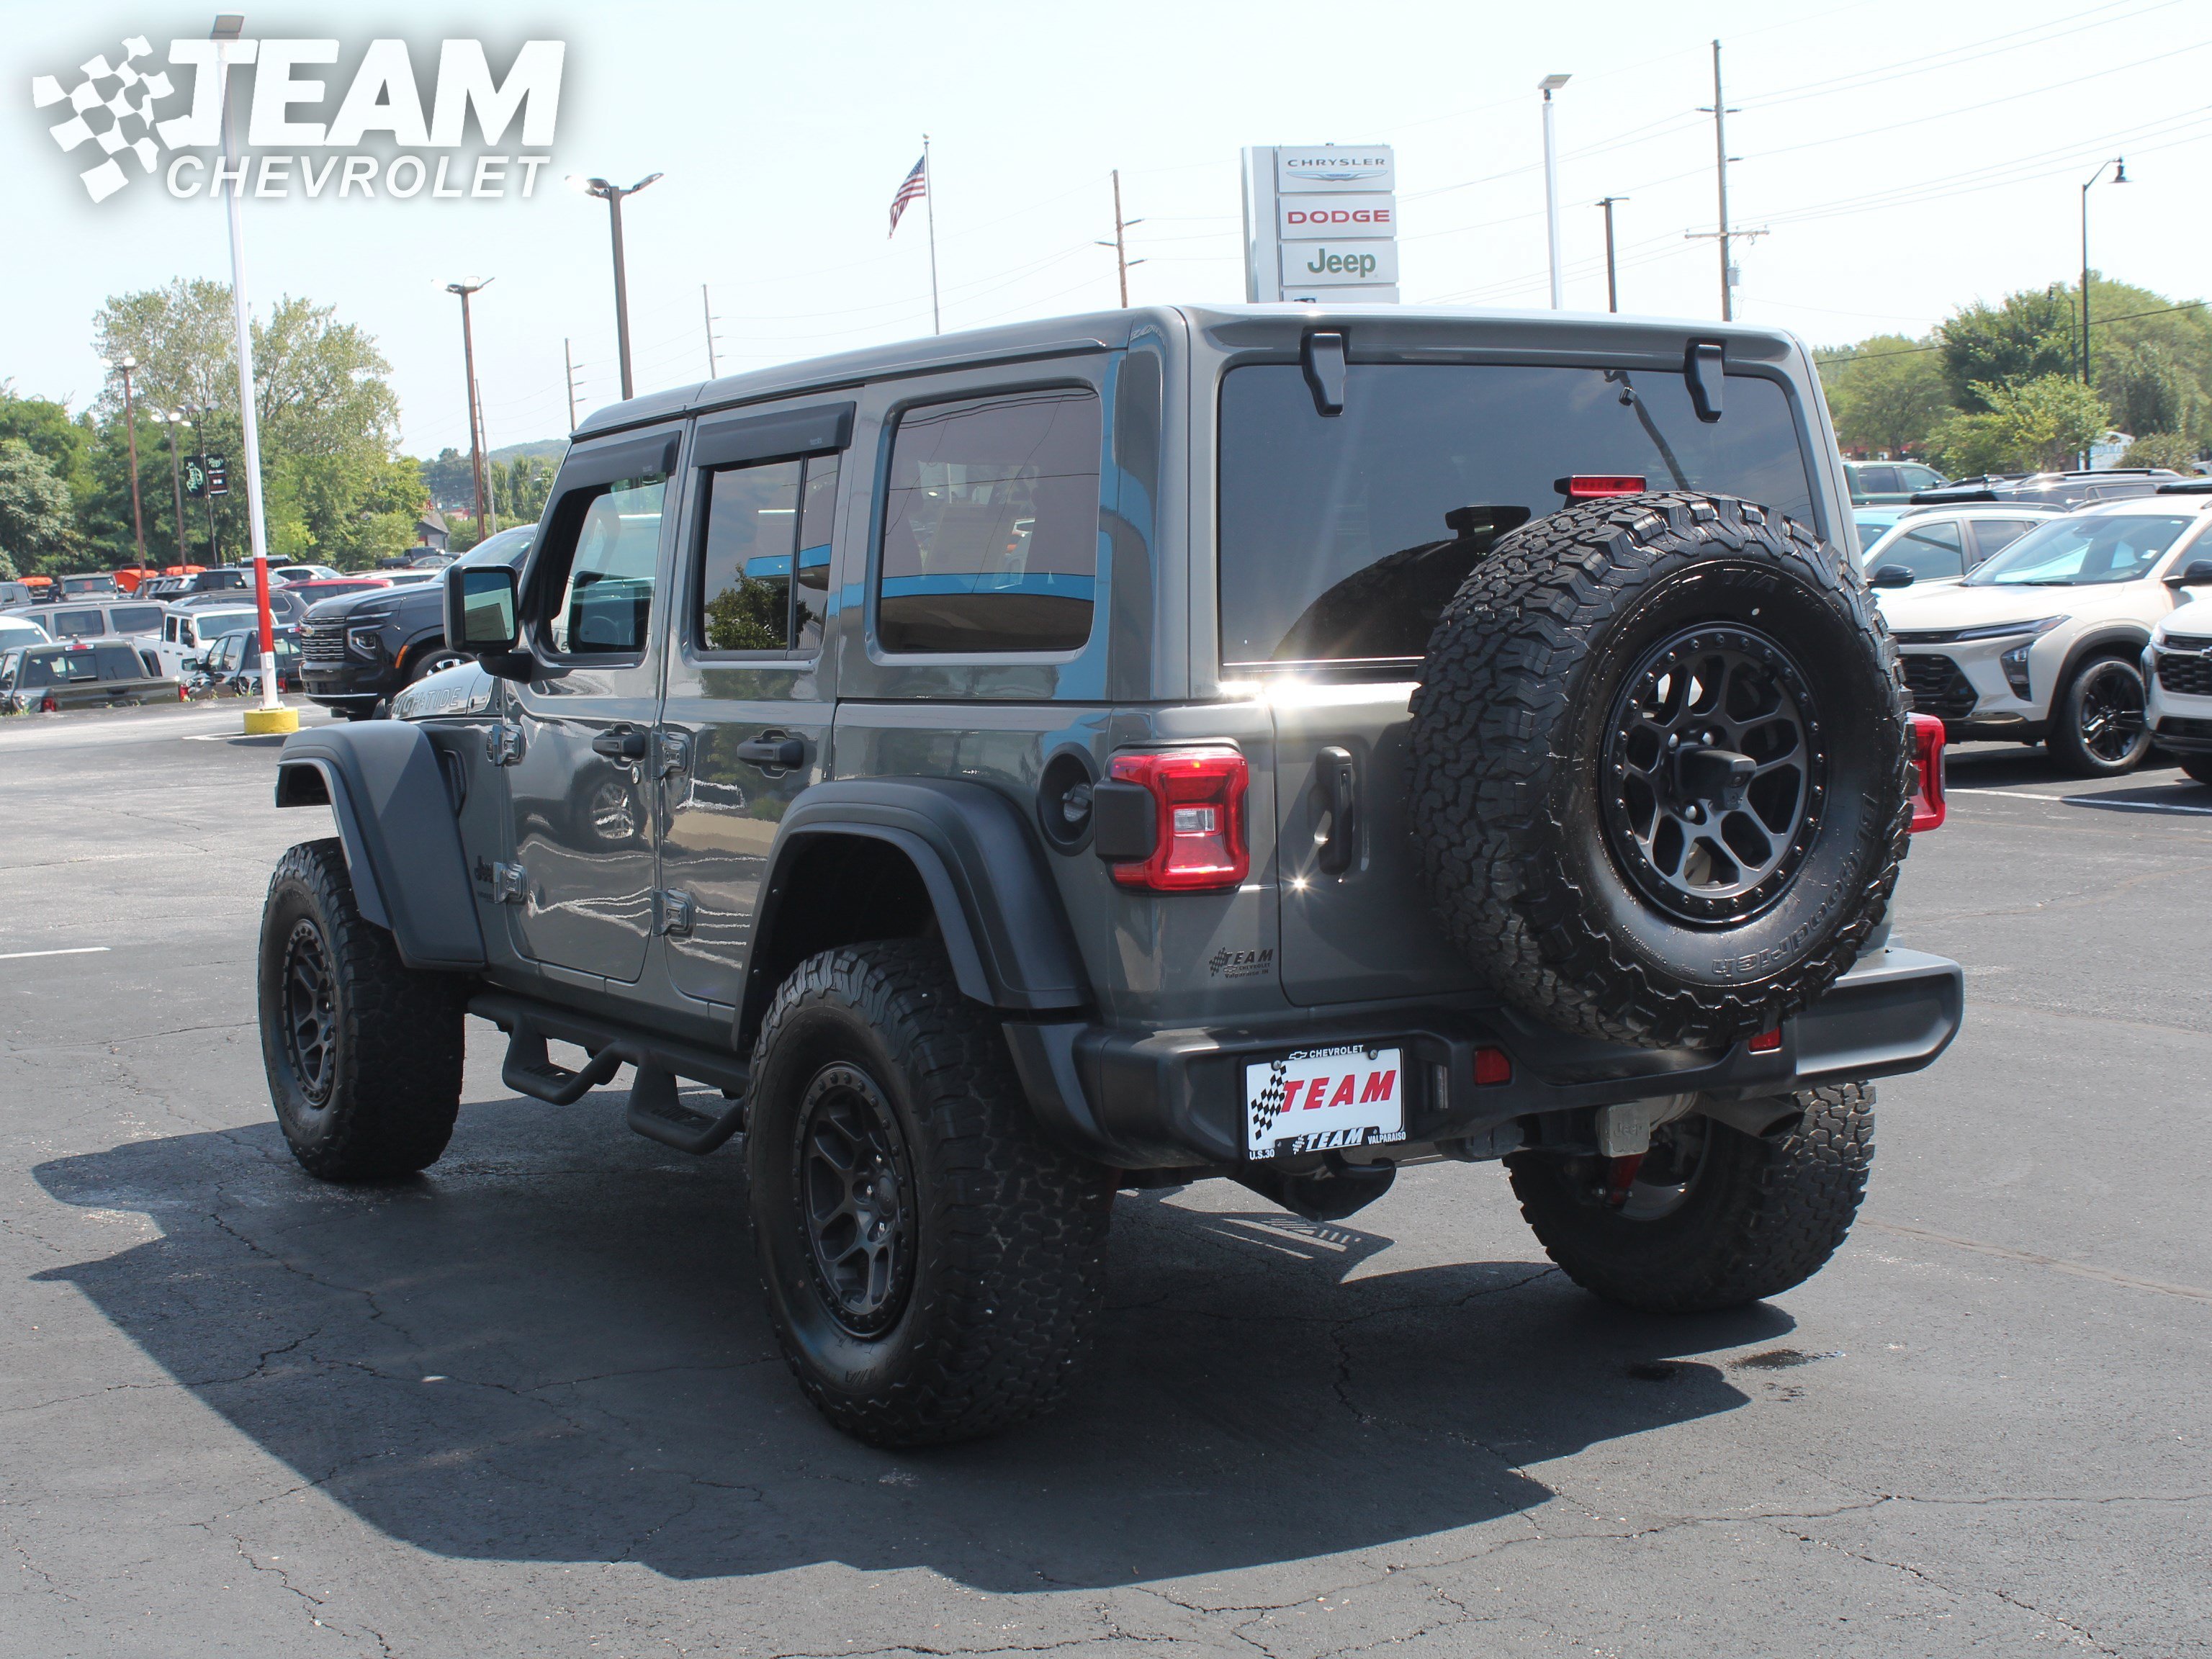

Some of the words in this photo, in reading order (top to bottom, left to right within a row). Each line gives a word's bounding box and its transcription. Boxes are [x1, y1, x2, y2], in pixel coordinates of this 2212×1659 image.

[1287, 158, 1385, 167] CHRYSLER
[1287, 210, 1390, 224] DODGE
[1307, 248, 1376, 278] Jeep
[426, 687, 462, 709] TIDE
[1224, 948, 1274, 966] TEAM
[1238, 962, 1271, 971] CHEVROLET
[1309, 1045, 1364, 1058] CHEVROLET
[1280, 1069, 1397, 1113] TEAM
[1305, 1127, 1364, 1151] TEAM
[1367, 1131, 1406, 1145] VALPARAISO
